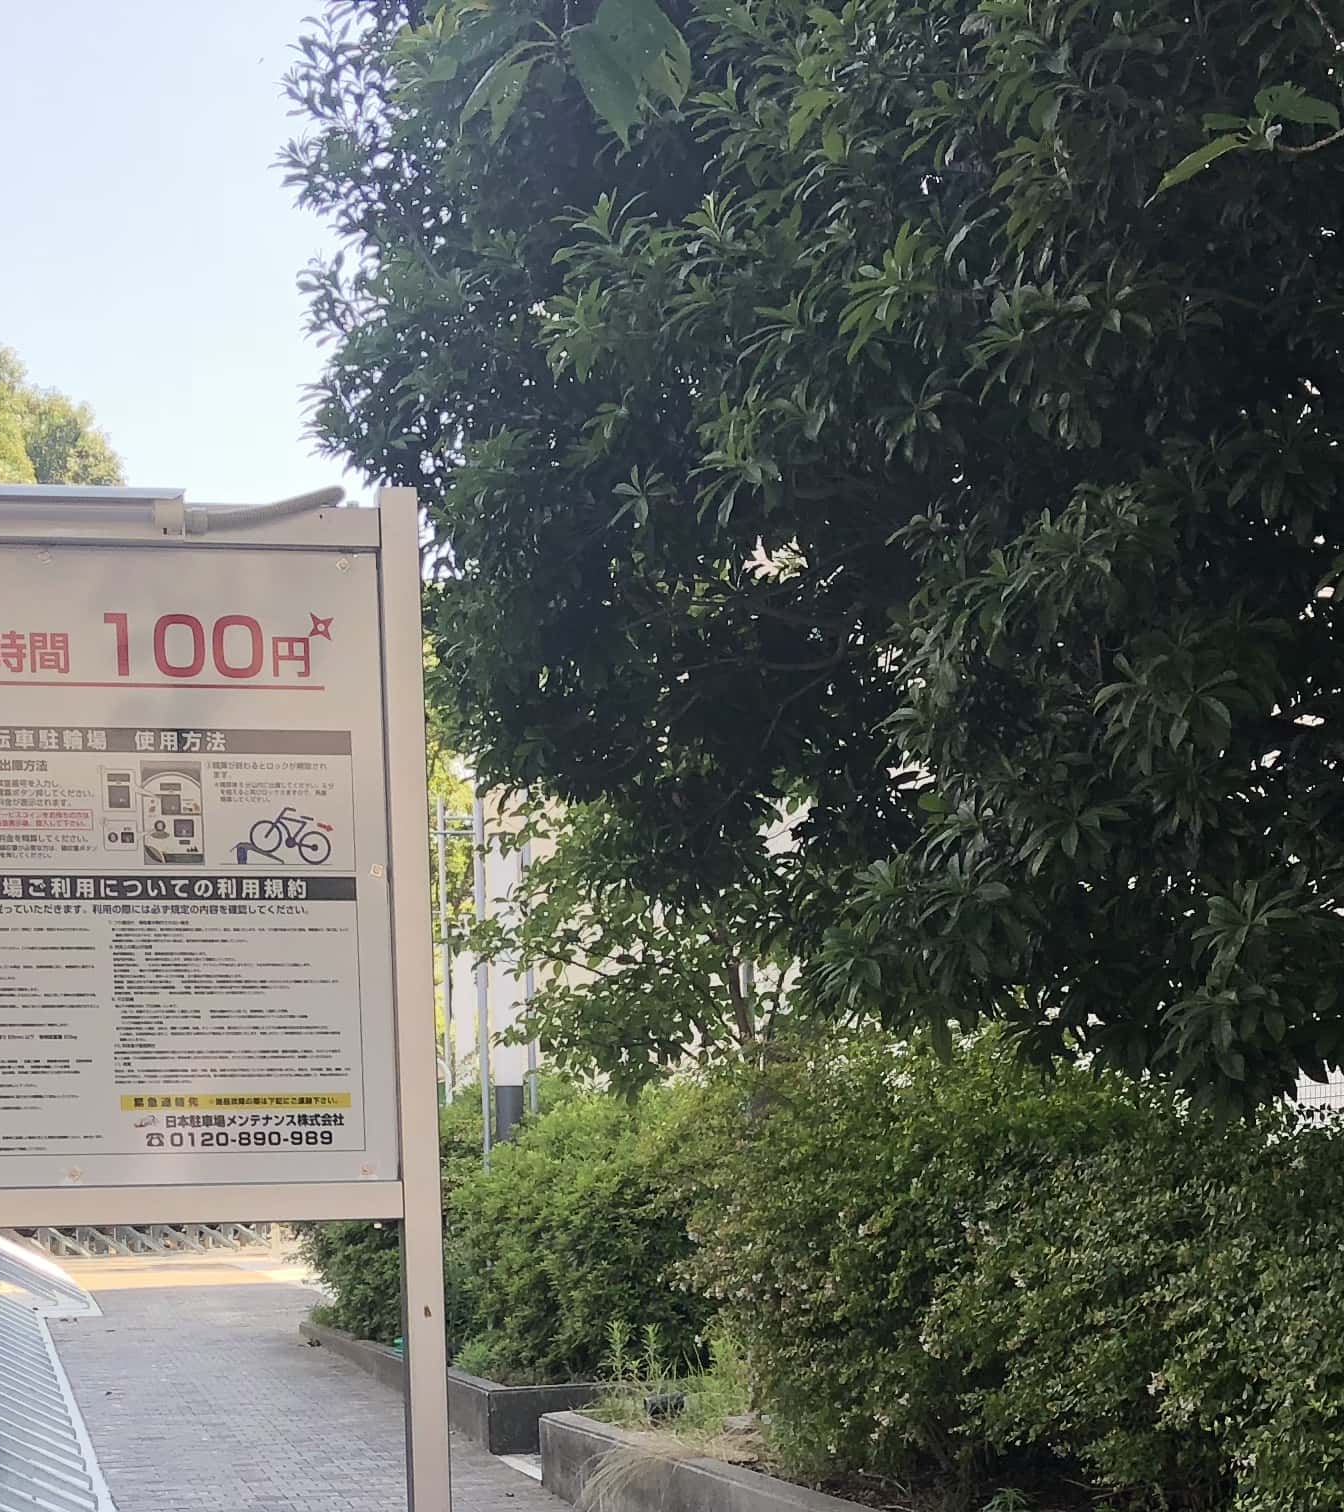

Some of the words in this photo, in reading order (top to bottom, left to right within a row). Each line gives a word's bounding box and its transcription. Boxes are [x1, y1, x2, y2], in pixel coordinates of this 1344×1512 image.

[103, 611, 312, 678] 100円
[134, 730, 227, 752] 使用方法
[0, 759, 48, 772] 出庫方法
[165, 1113, 345, 1129] 日本駐車場メンテナンス株式会社
[170, 1131, 334, 1147] 0120-890-989
